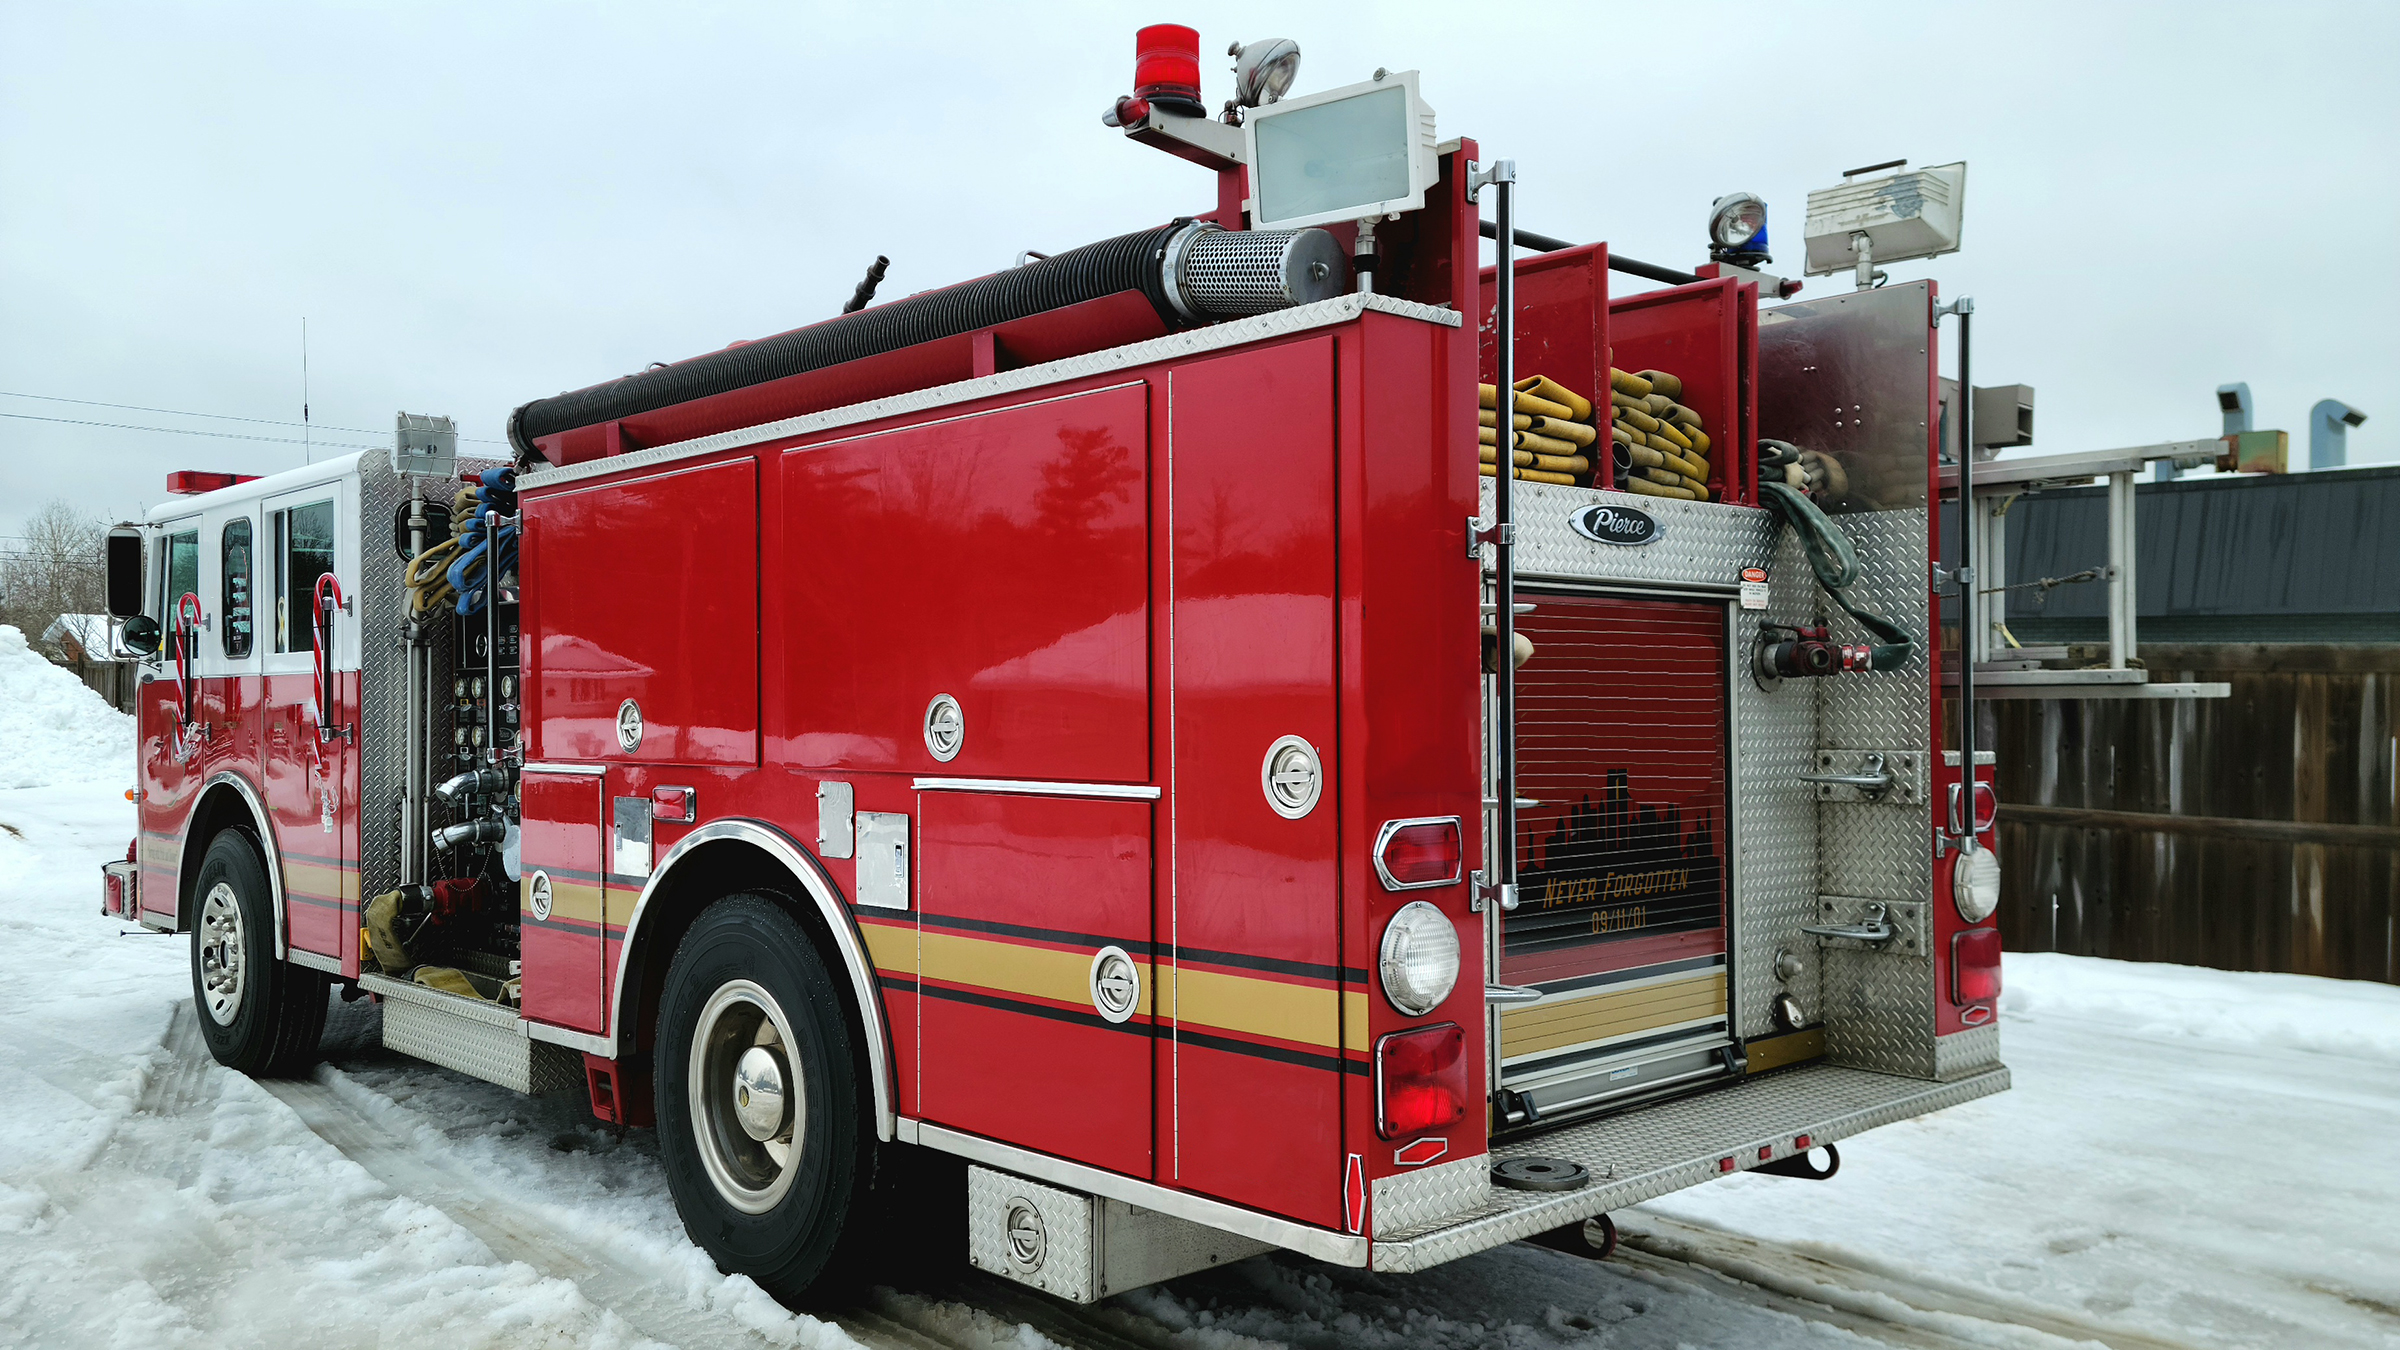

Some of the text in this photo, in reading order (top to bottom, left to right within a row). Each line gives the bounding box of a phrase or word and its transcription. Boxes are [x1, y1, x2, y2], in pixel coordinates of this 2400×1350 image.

[1593, 508, 1646, 535] Pierce
[1744, 570, 1765, 579] DANGER
[1543, 868, 1689, 908] NEVER FORGOTTEN
[1592, 906, 1647, 934] 09/11/01
